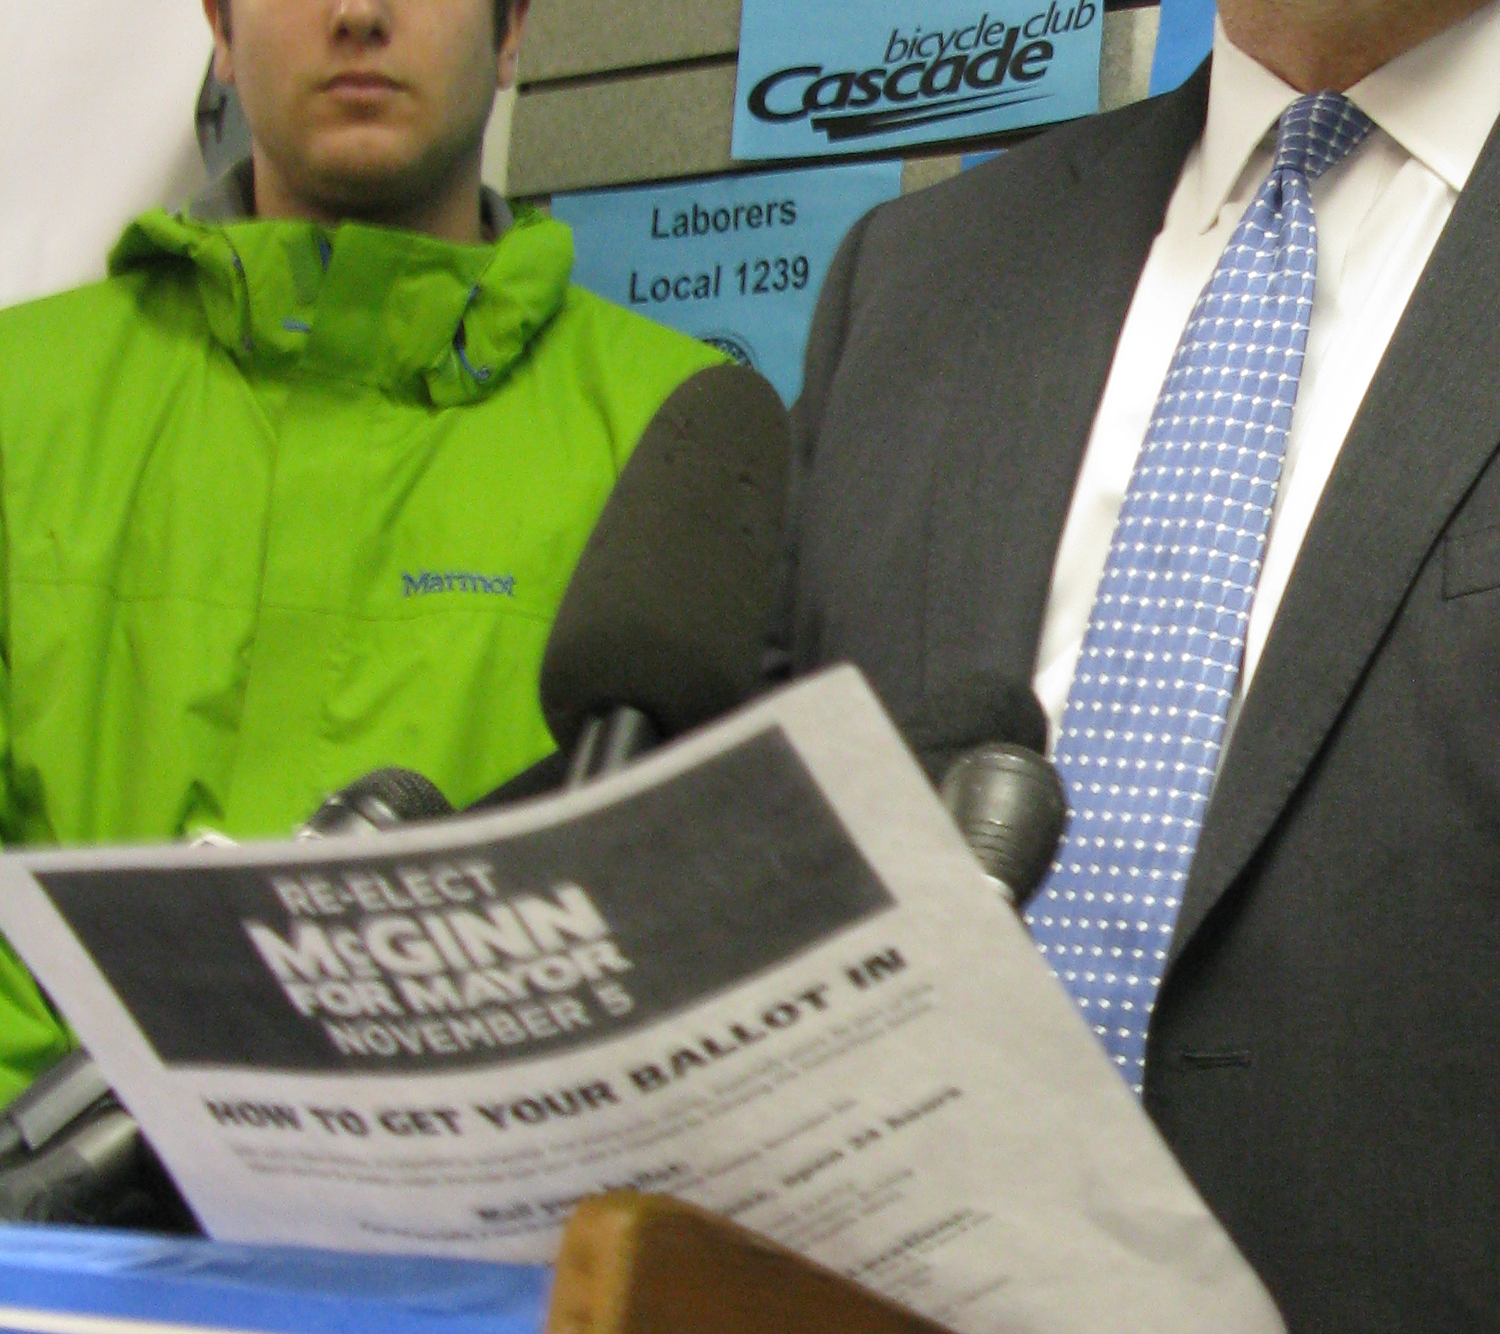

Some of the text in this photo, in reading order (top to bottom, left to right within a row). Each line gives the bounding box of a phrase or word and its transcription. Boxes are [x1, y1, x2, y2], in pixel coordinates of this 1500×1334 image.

[883, 12, 1006, 65] bicycle
[746, 25, 1055, 123] Cascade
[651, 198, 797, 240] Laborers
[628, 254, 810, 306] Local 1239
[271, 860, 498, 917] RE-ELECT
[282, 938, 636, 1019] FOR MAYOR
[203, 944, 910, 1139] HOW TO GET YOUR BALLOT IN
[322, 979, 637, 1059] NOVEMBER 5
